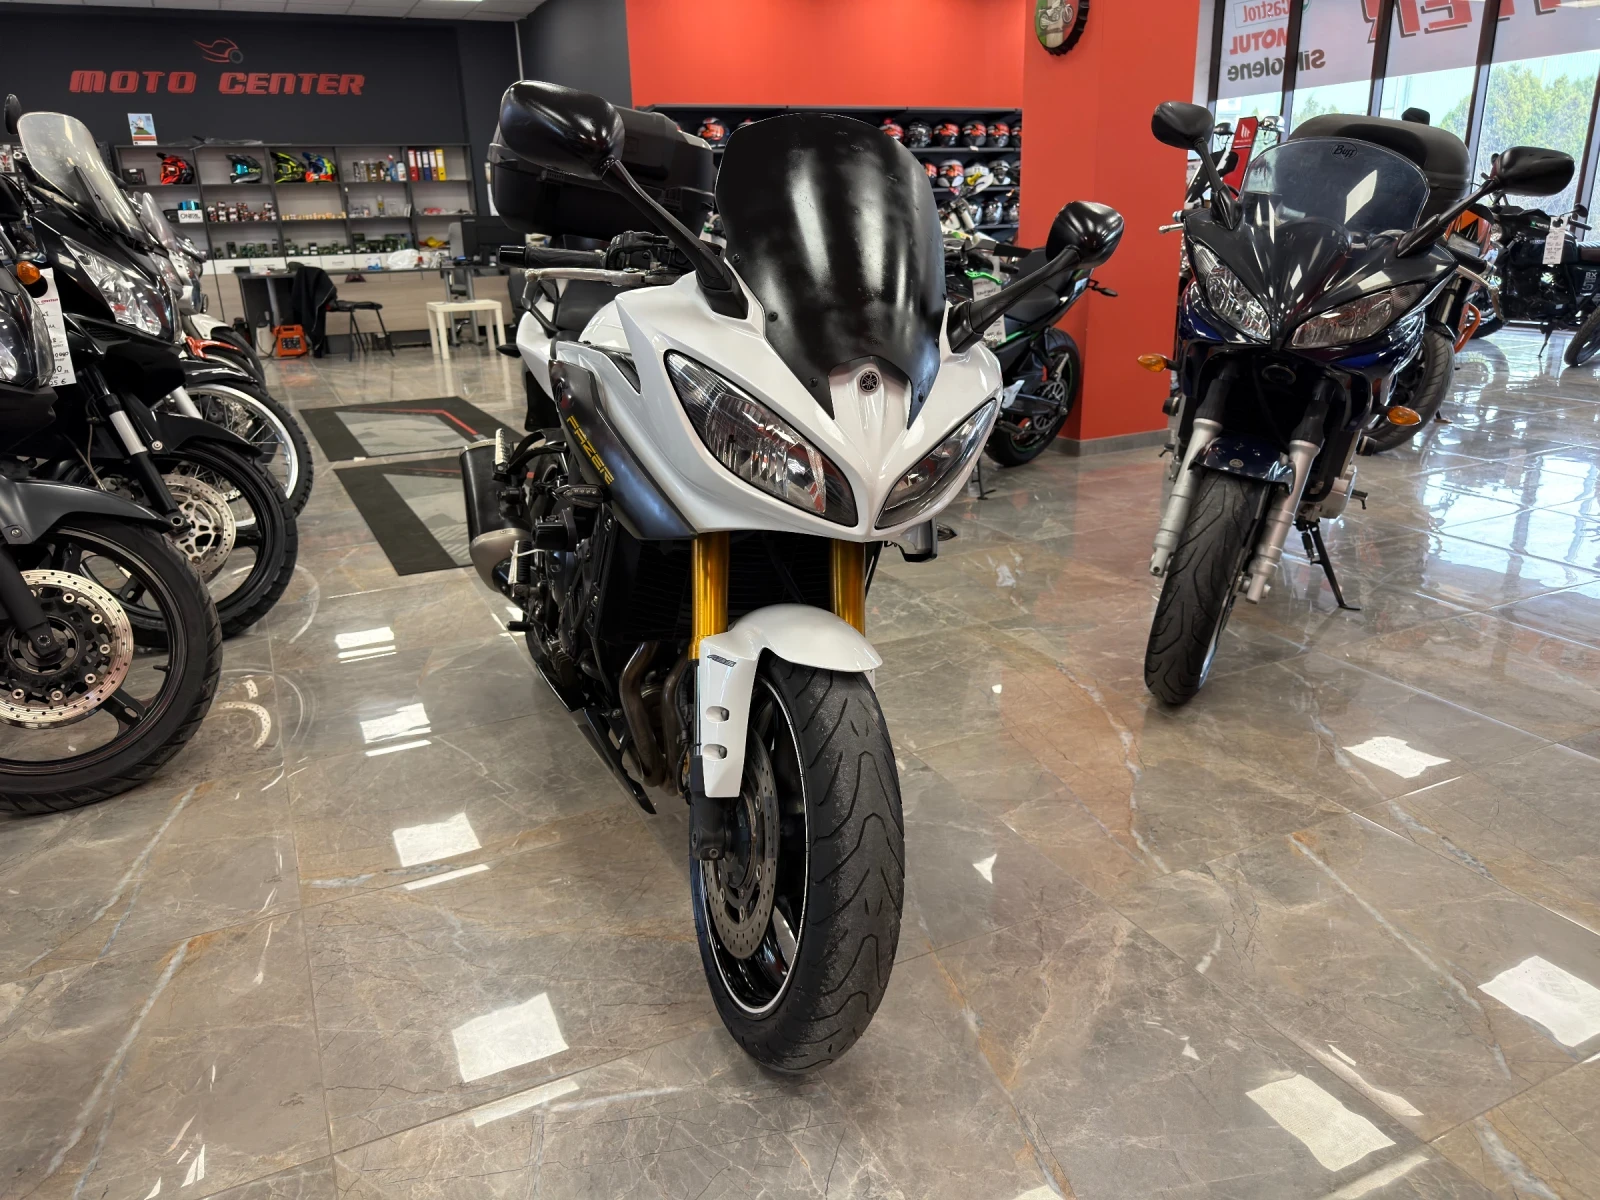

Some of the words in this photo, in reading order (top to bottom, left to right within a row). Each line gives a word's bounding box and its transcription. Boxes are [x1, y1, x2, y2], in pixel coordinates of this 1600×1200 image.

[69, 70, 197, 93] MOTO
[218, 72, 365, 95] CENTER
[566, 415, 615, 485] FAZER
